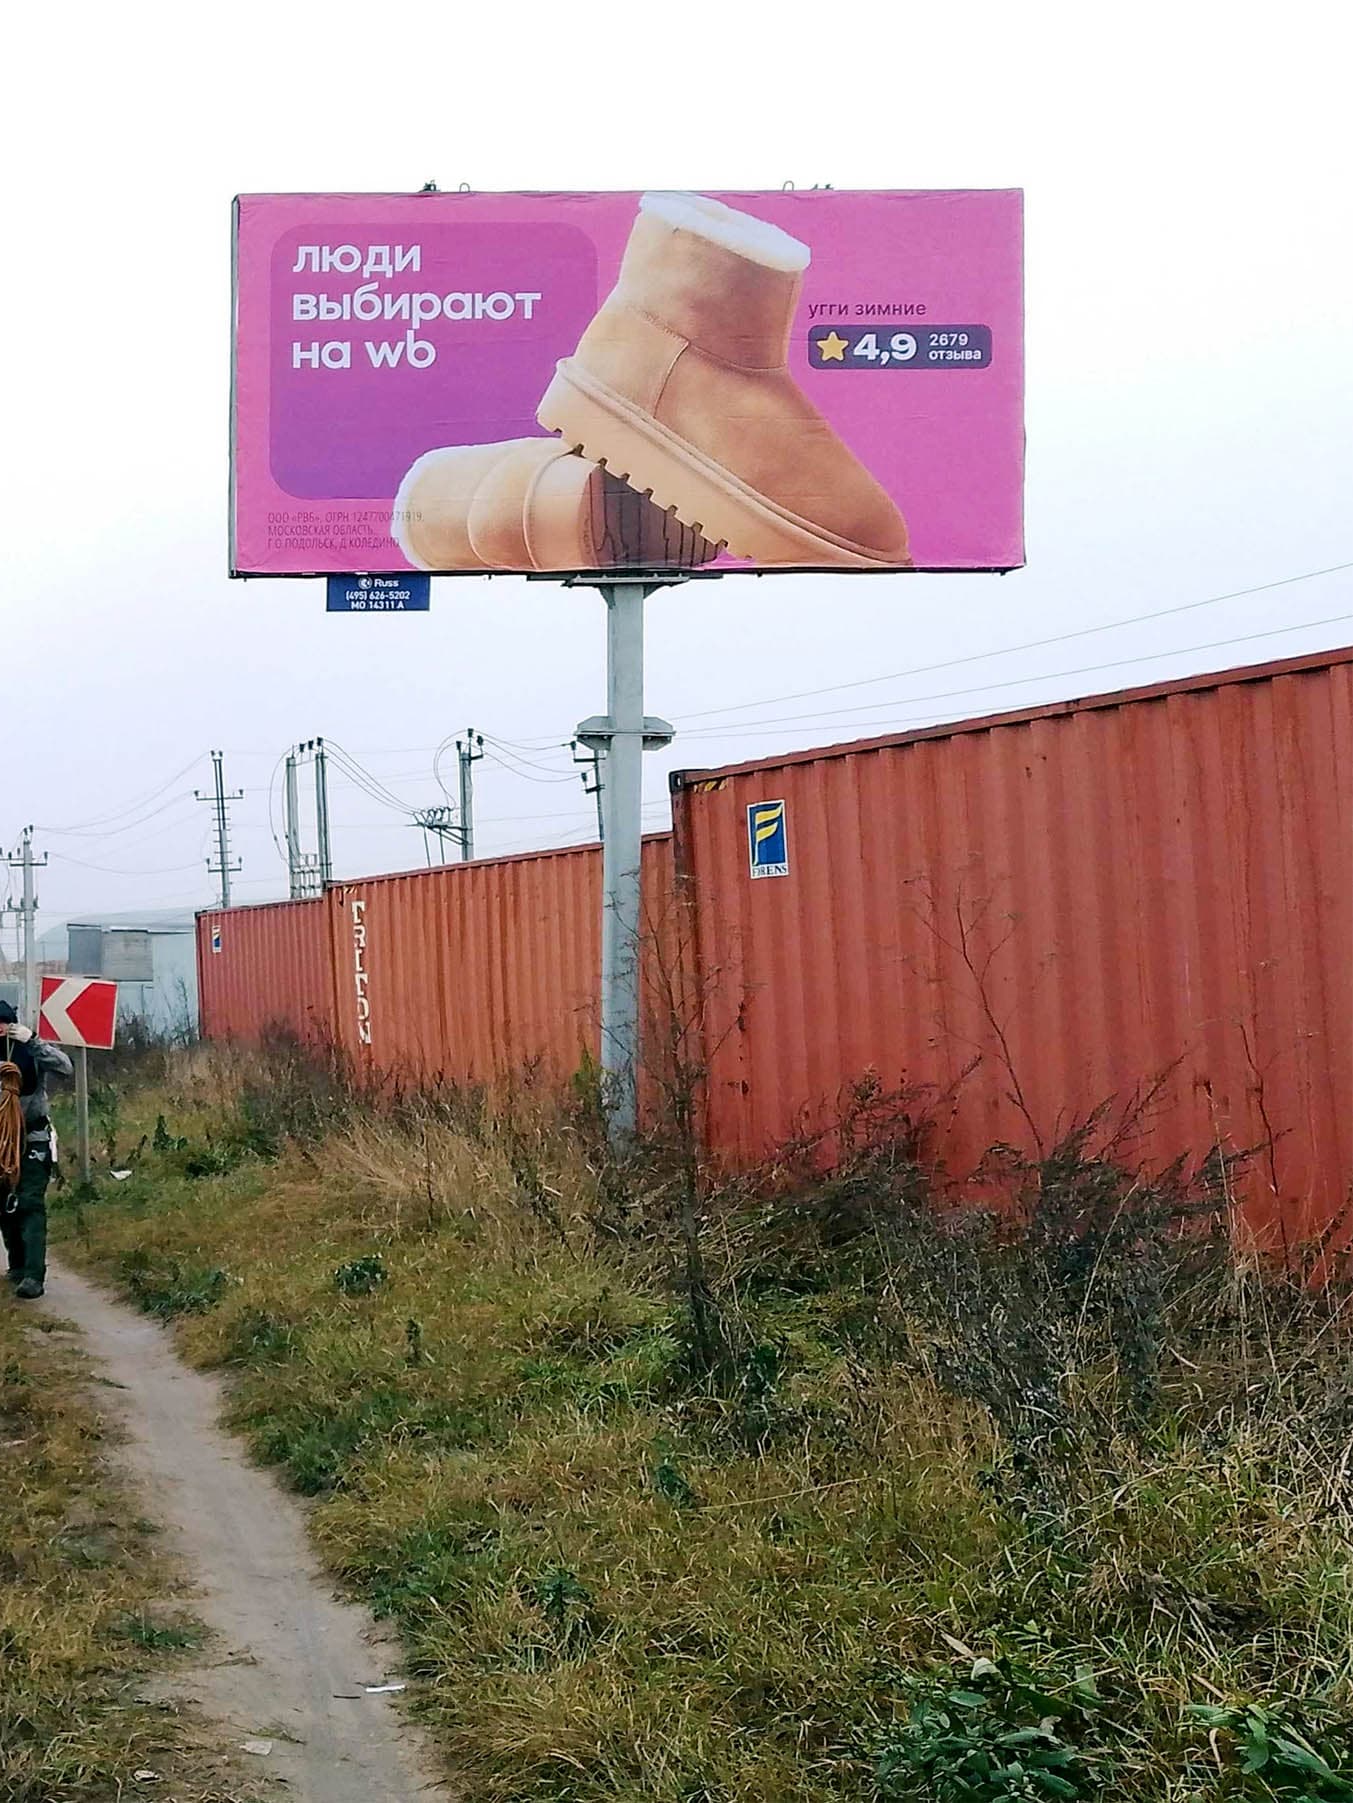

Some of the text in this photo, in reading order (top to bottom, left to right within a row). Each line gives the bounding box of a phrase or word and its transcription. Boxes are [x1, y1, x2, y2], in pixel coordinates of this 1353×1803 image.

[292, 244, 421, 278] люди
[292, 282, 542, 329] выбирают
[808, 303, 927, 319] угги зимние
[928, 333, 969, 346] 2679
[292, 330, 436, 369] на wb
[853, 333, 917, 366] 4,9
[928, 349, 982, 360] отзыва
[267, 511, 290, 523] ООО
[325, 511, 349, 523] ОГРН
[267, 525, 330, 536] МОСКОВСКАЯ
[374, 578, 399, 587] Russ
[345, 591, 411, 600] (495) 626-5202
[351, 601, 366, 609] МО
[369, 601, 394, 609] 14311
